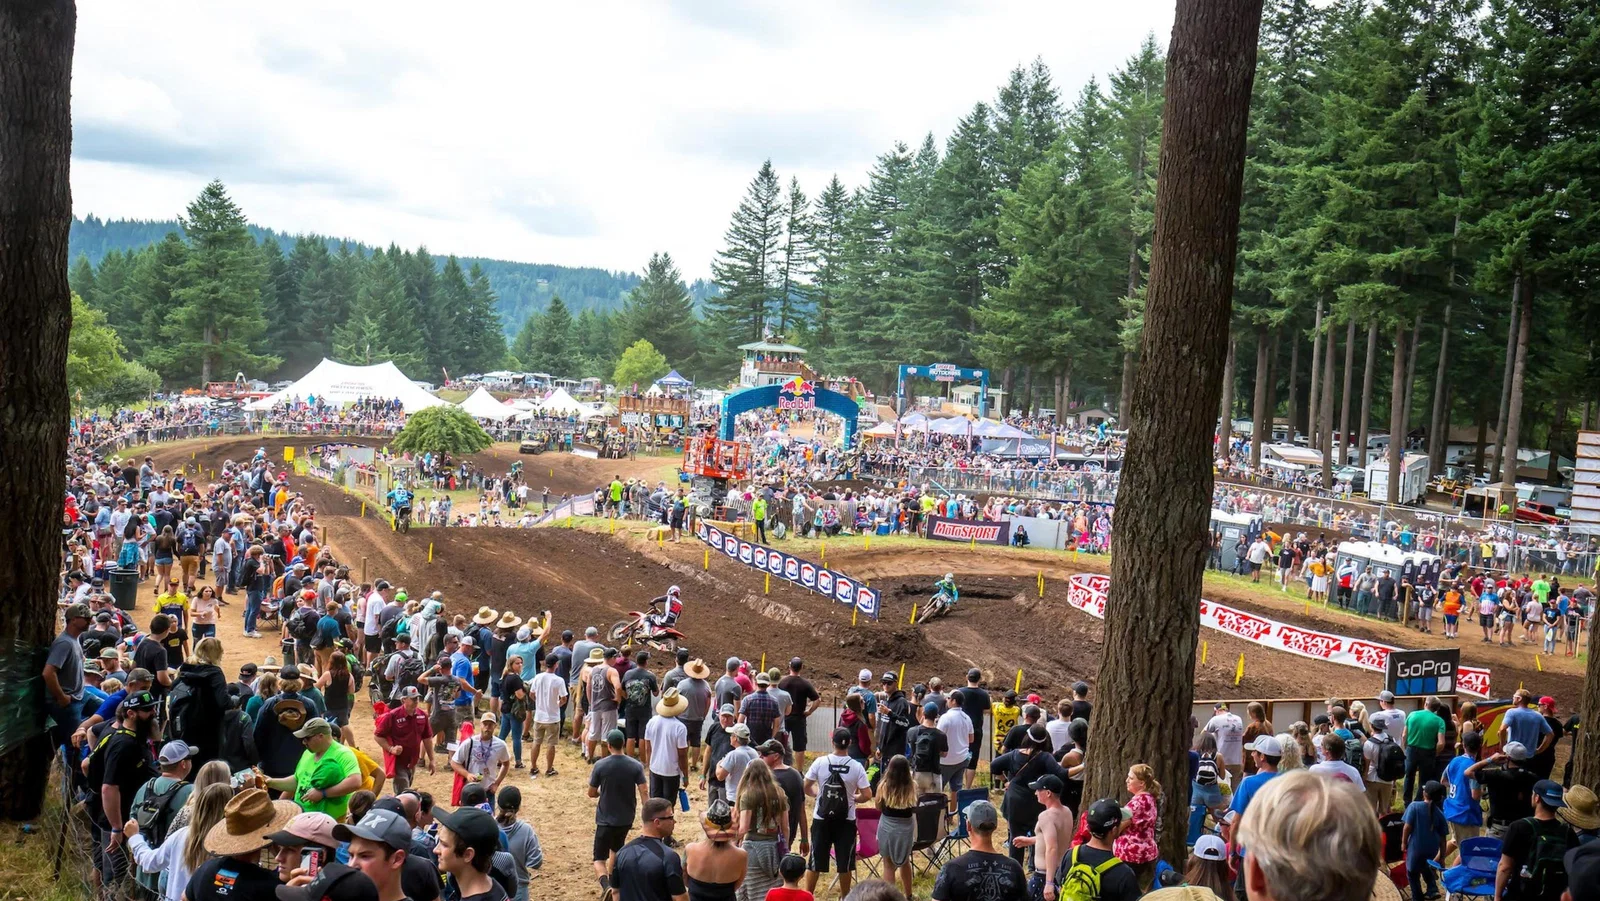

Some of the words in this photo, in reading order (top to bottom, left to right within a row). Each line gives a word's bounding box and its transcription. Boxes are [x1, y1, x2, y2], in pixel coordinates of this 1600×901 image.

[779, 396, 798, 409] Red
[798, 397, 815, 409] Bull
[1217, 609, 1240, 625] MX
[1241, 618, 1272, 634] ATV
[1281, 628, 1306, 645] MX
[1307, 636, 1341, 651] ATV
[1288, 642, 1306, 653] ALL
[1307, 645, 1328, 657] OUT
[1351, 643, 1380, 659] MX
[1397, 660, 1451, 678] GoPro
